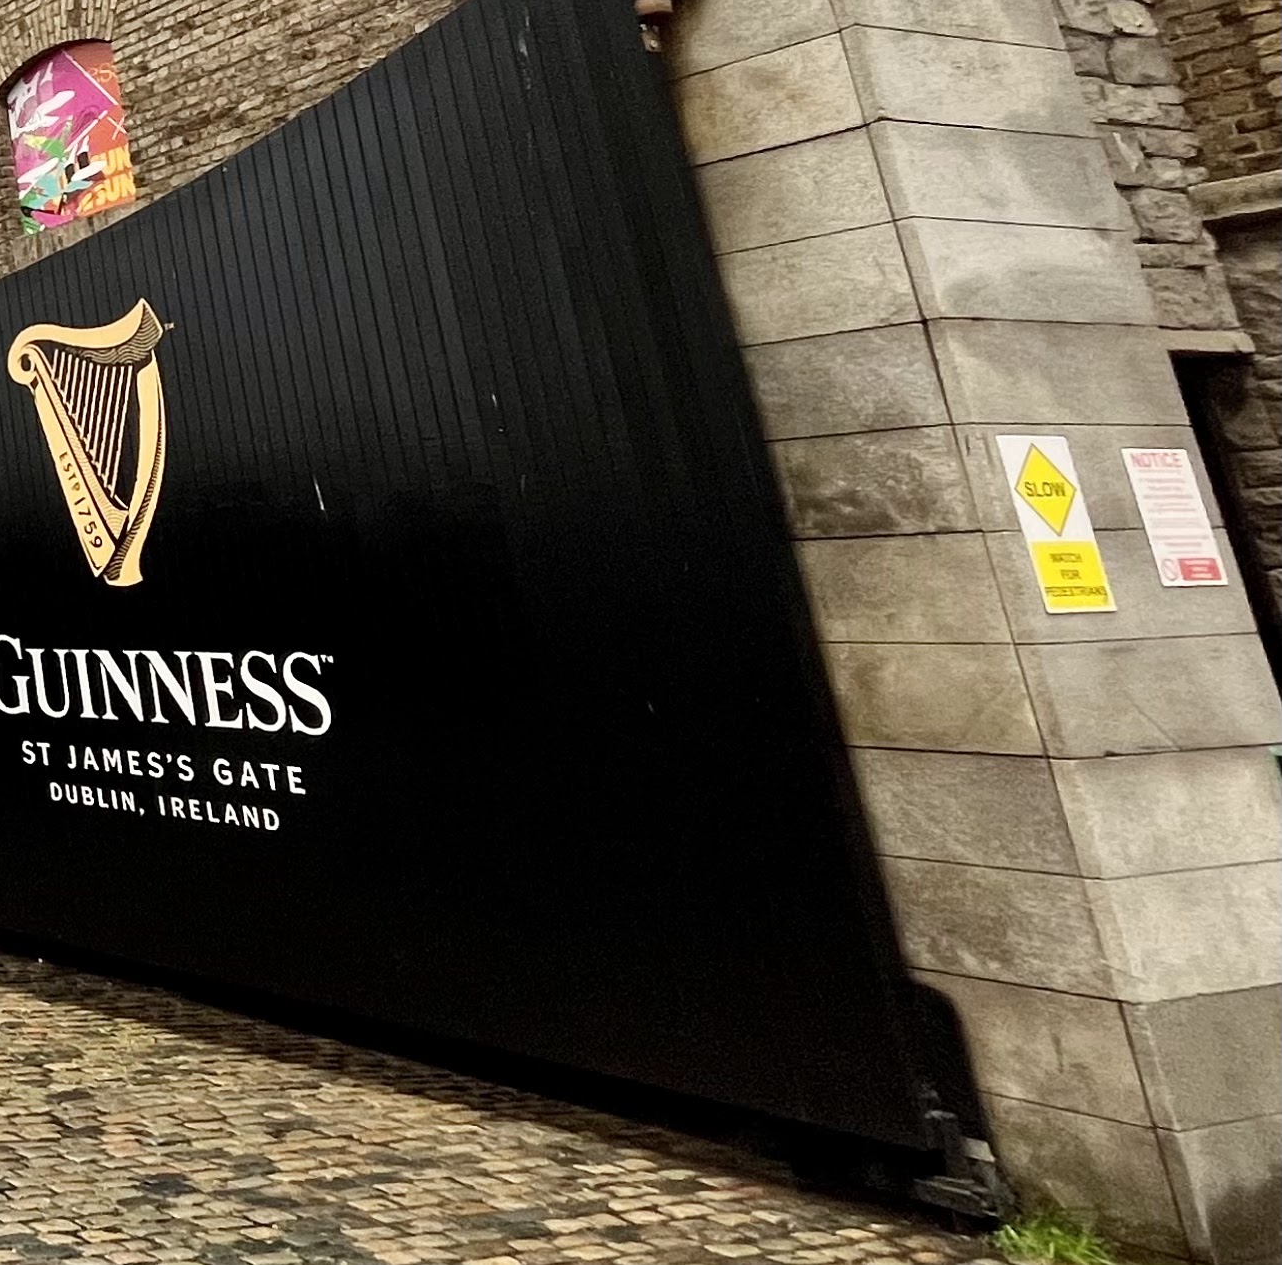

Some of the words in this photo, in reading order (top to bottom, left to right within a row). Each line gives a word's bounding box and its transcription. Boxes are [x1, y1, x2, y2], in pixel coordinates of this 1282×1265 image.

[1130, 452, 1183, 468] NOTICE
[1024, 481, 1066, 497] SLOW
[74, 497, 103, 548] 1759
[1060, 569, 1082, 580] FOR
[21, 740, 51, 766] ST
[67, 744, 195, 782] JAMES'S
[213, 758, 307, 795] GATE
[50, 781, 145, 816] DUBLIN,
[158, 795, 280, 831] IRELAND
